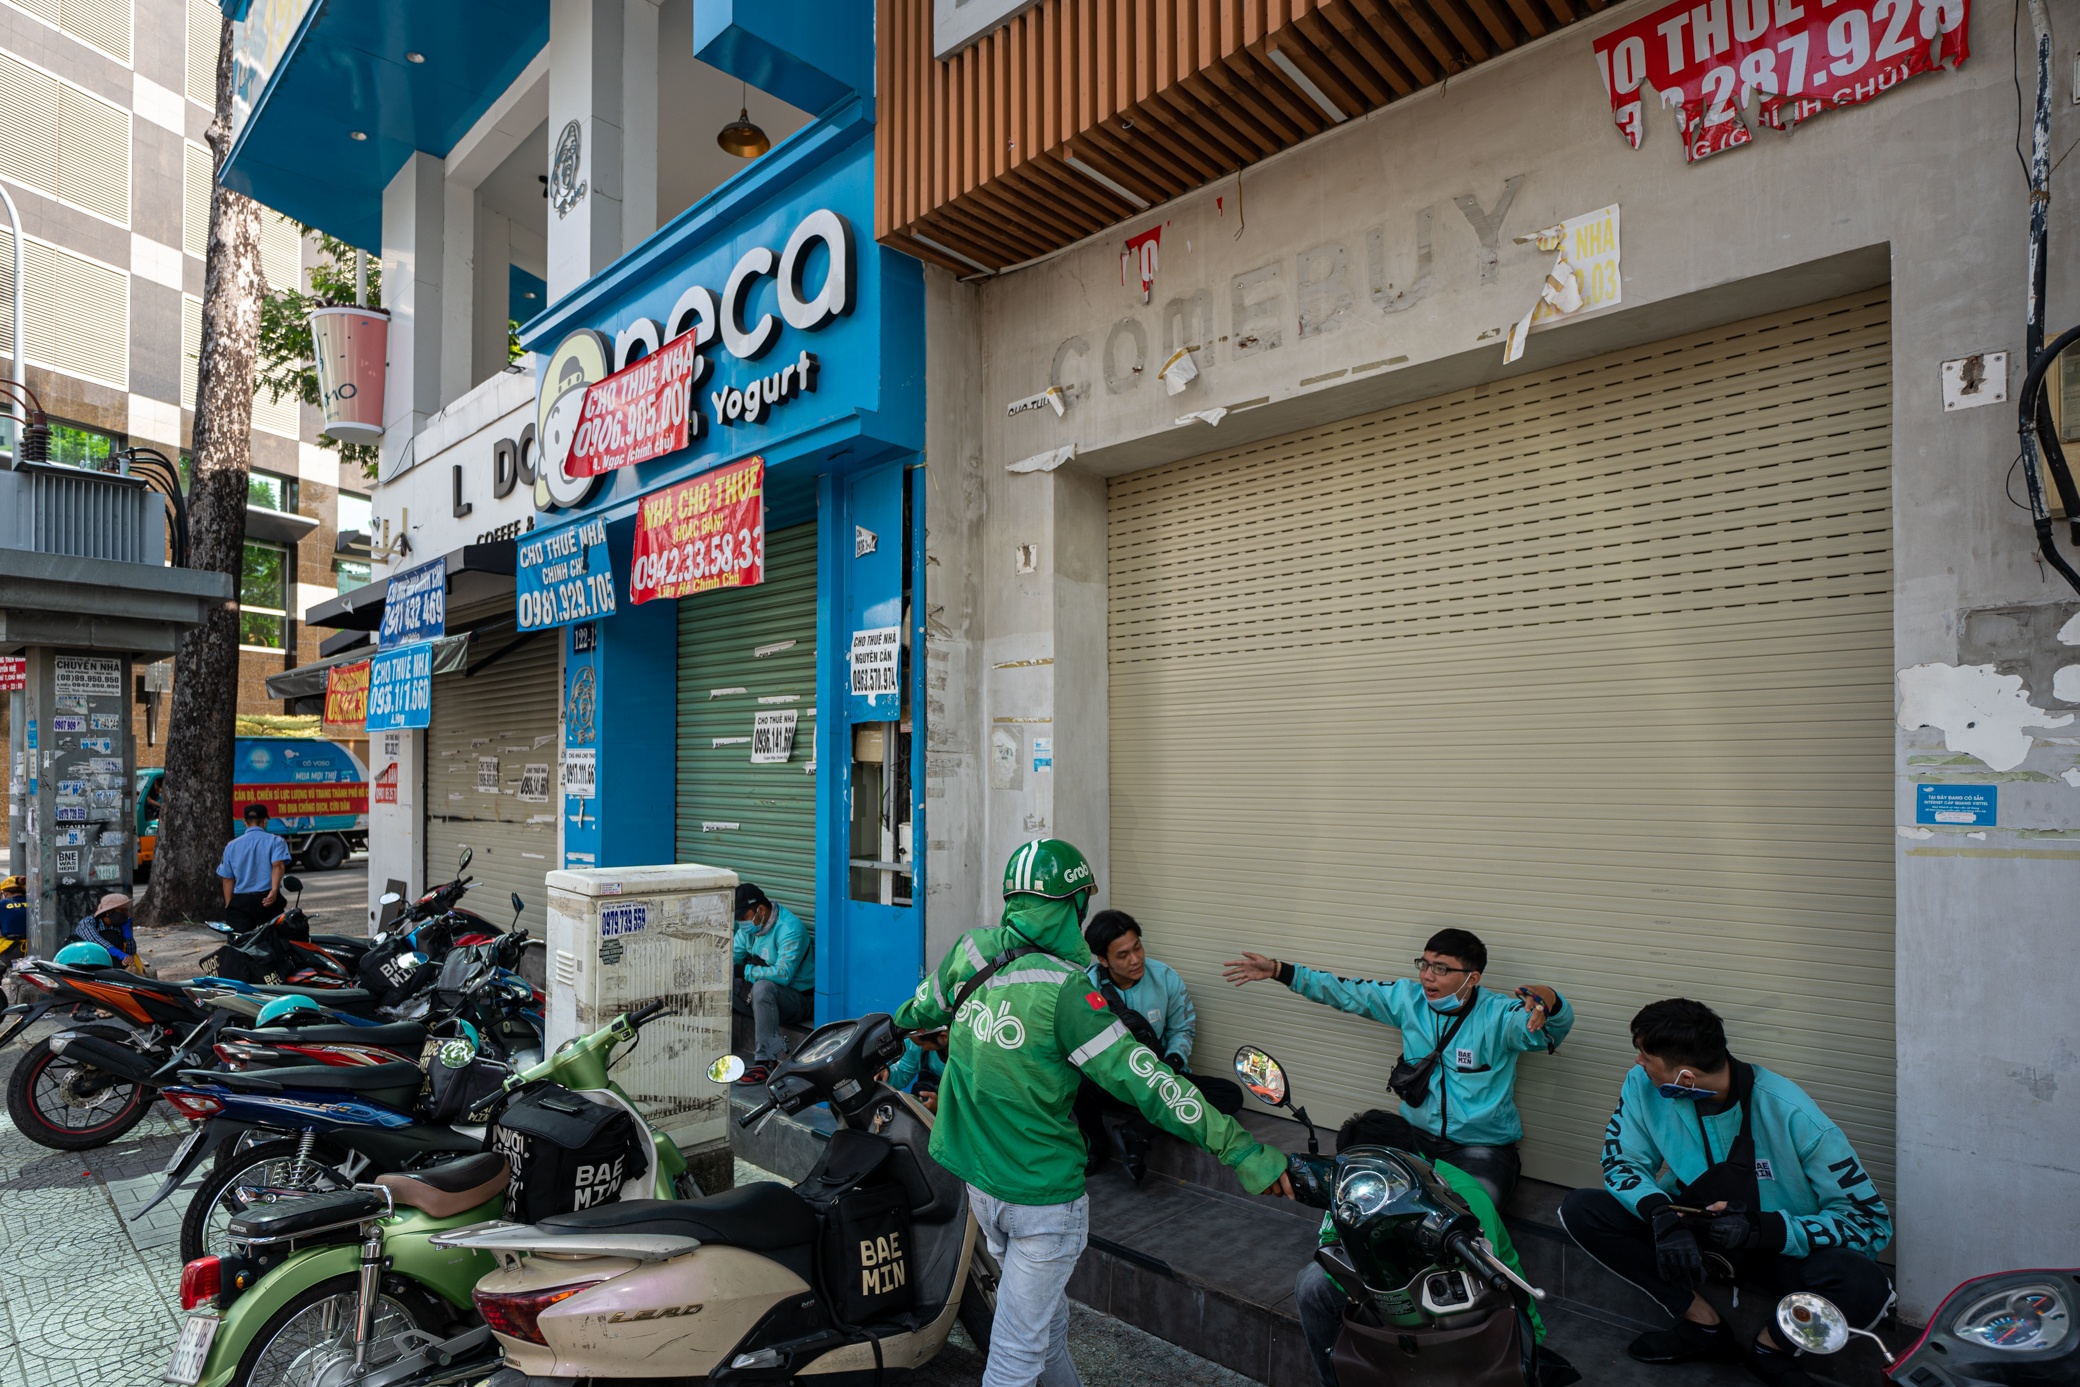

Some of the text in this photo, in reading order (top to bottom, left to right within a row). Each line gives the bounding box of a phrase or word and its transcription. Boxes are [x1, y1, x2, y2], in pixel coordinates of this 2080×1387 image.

[1576, 209, 1616, 261] NHÀ
[585, 381, 617, 418] CHO
[621, 353, 657, 404] THUÊ
[661, 334, 693, 384] NHÀ
[711, 350, 816, 425] Yogurt
[603, 454, 624, 470] Ngọc
[644, 457, 760, 531] NHÀ CHO THUÊ
[520, 542, 544, 568] CHO
[545, 527, 578, 560] THUÊ
[634, 526, 761, 591] 0942.33.58.33
[542, 561, 568, 585] CHÍNH
[693, 575, 719, 591] Chính
[423, 589, 443, 625] 469
[519, 571, 616, 628] 0981.929.705
[854, 629, 896, 648] CHO THUÊ NHÀ
[101, 661, 120, 672] NHÀ
[374, 646, 429, 686] CHO THUÊ NHÀ
[855, 649, 878, 664] NGUYÊN
[853, 666, 896, 692] 0963.570.974
[757, 712, 795, 725] CHO THUÊ NHÀ
[59, 852, 77, 861] BNE
[1064, 861, 1090, 884] Grab
[602, 907, 646, 936] 0979.739.559
[1458, 1057, 1471, 1065] MIN
[1130, 1047, 1203, 1124] Grab
[575, 1153, 625, 1187] BAE
[1756, 1162, 1769, 1170] AE
[573, 1174, 622, 1212] MIN
[860, 1231, 903, 1267] BAE
[862, 1259, 906, 1296] MIN
[608, 1303, 704, 1324] LEAD
